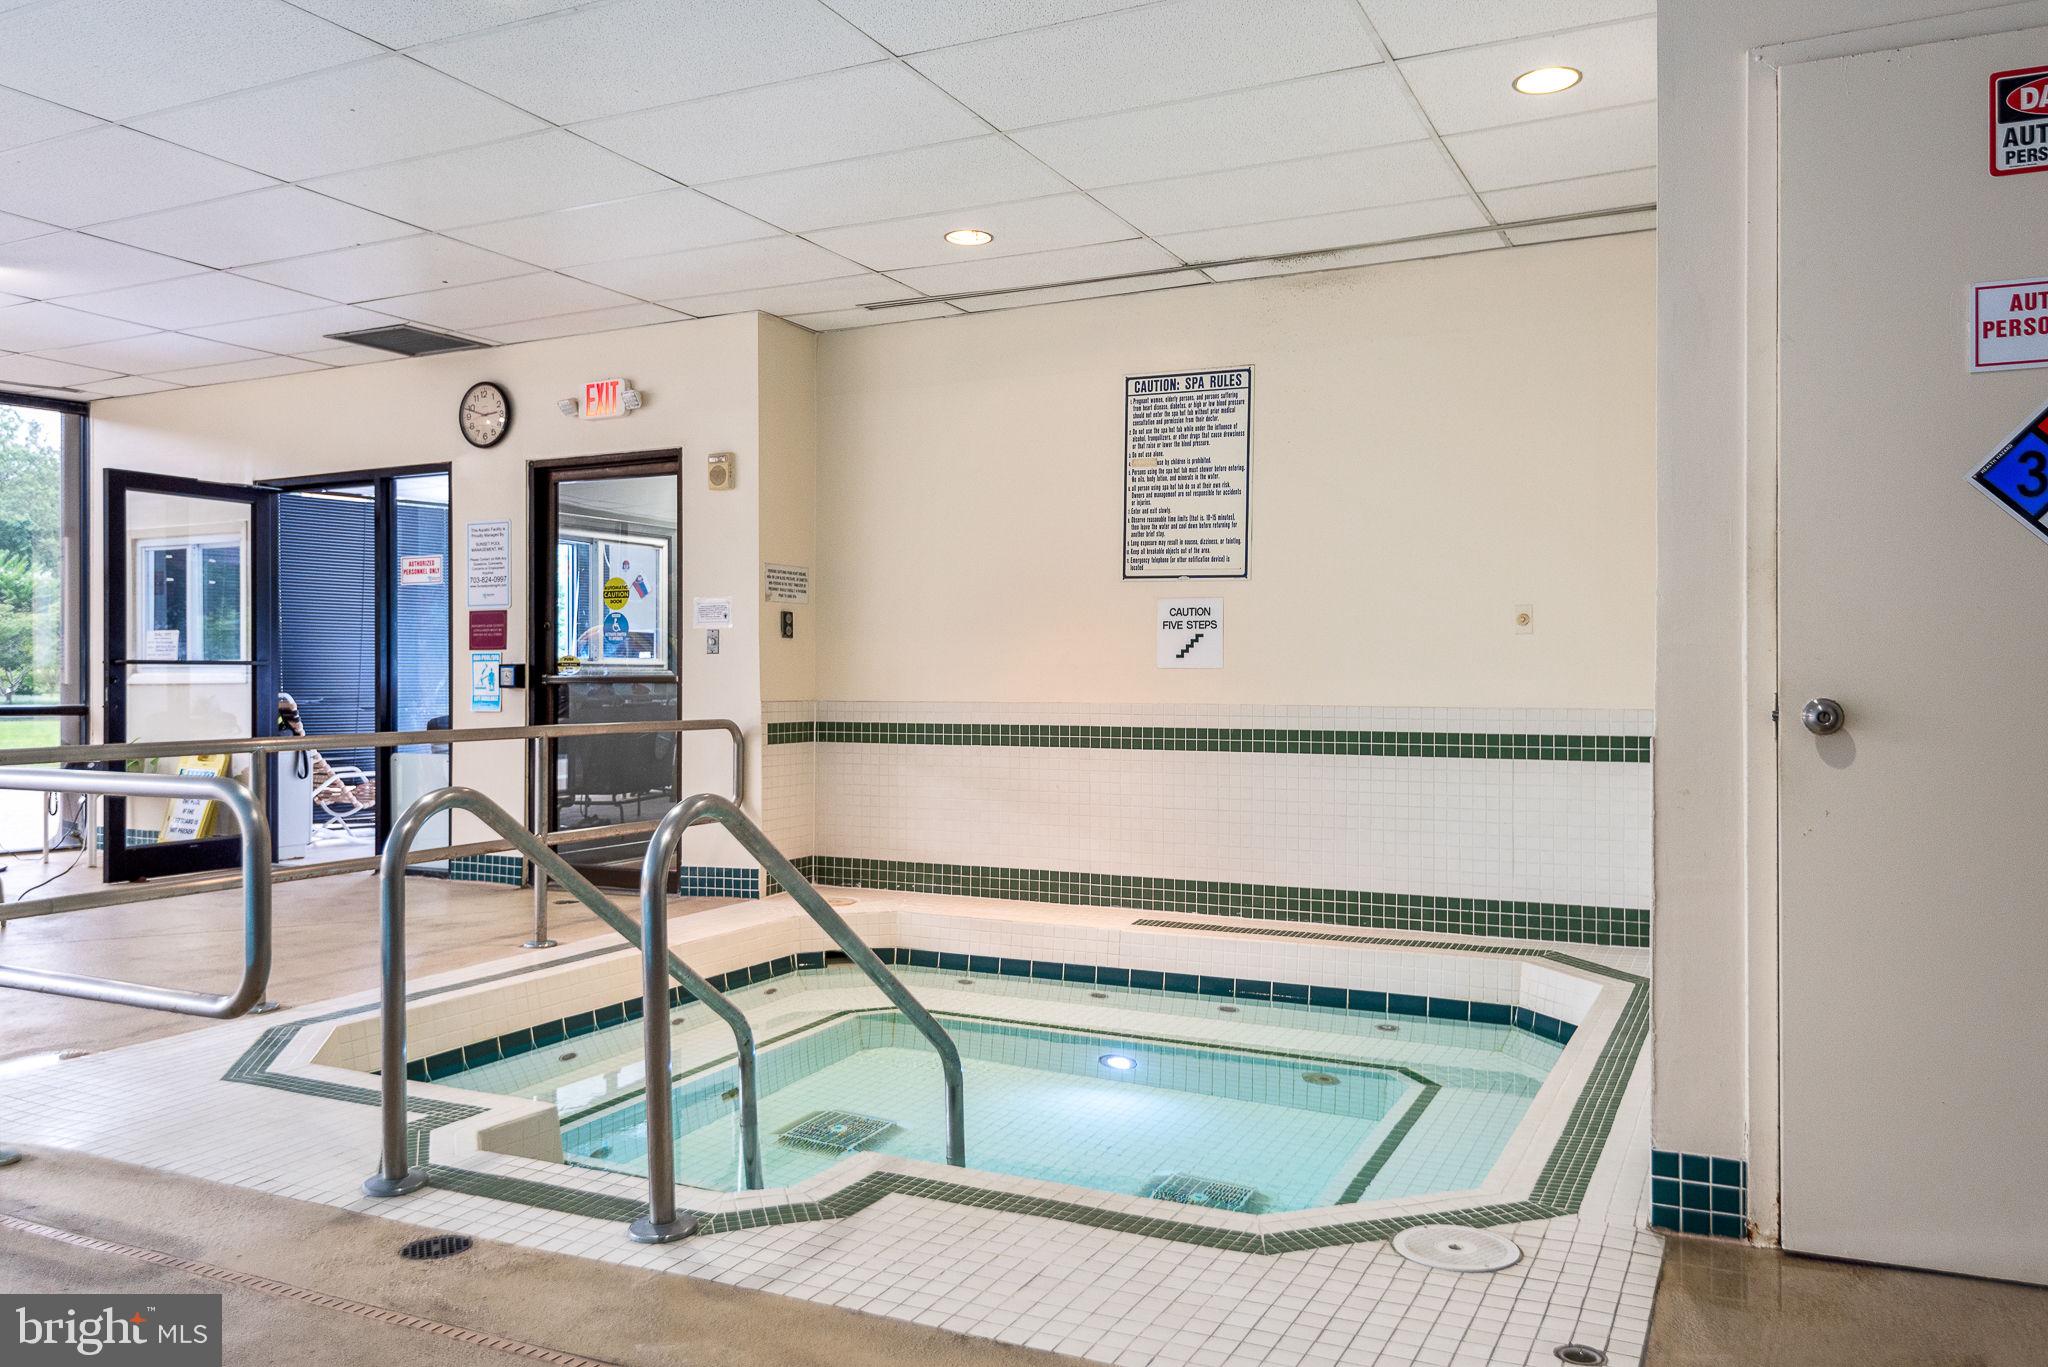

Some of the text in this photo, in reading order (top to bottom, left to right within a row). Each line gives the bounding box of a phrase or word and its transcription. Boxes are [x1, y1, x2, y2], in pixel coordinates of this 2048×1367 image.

[2003, 124, 2048, 148] AUT
[2006, 147, 2048, 165] PERS
[2010, 291, 2048, 311] AUT
[1983, 316, 2048, 339] PERSO
[1134, 373, 1242, 393] CAUTION: SPA RULES
[474, 395, 479, 403] 11
[481, 390, 487, 398] 12
[586, 381, 619, 417] EXIT
[483, 432, 488, 440] 6
[1981, 444, 2013, 474] HEALTH HAZARD
[2017, 450, 2048, 498] 3
[1169, 607, 1211, 616] CAUTION
[1163, 620, 1218, 629] FIVE STEPS
